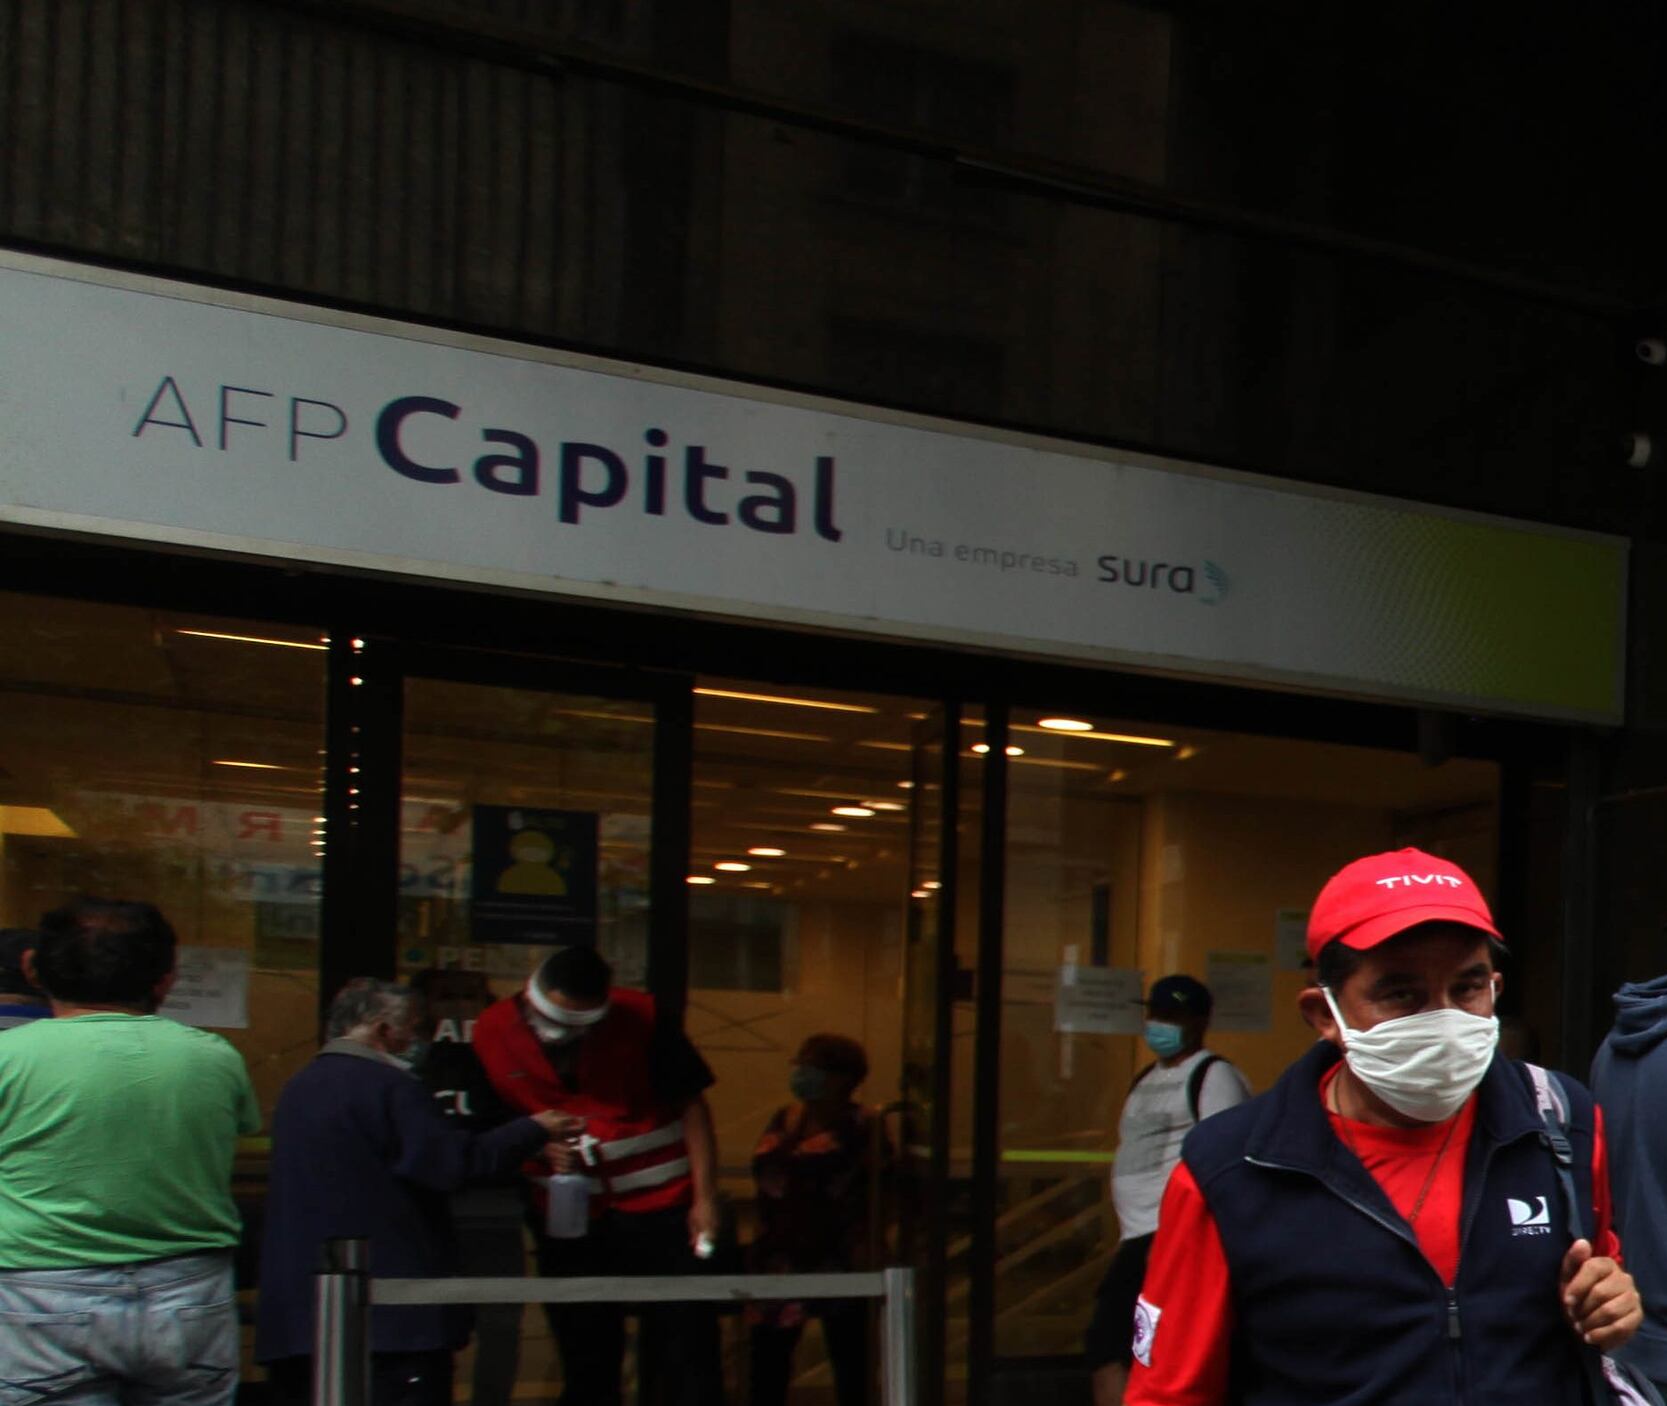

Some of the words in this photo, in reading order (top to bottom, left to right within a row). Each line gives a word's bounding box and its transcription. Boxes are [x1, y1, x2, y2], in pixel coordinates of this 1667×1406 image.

[132, 376, 349, 461] AFP
[374, 395, 843, 543] Capital
[885, 526, 944, 560] Una
[953, 542, 1081, 580] empresa
[1097, 552, 1194, 594] sura
[1376, 874, 1463, 889] TIVIT
